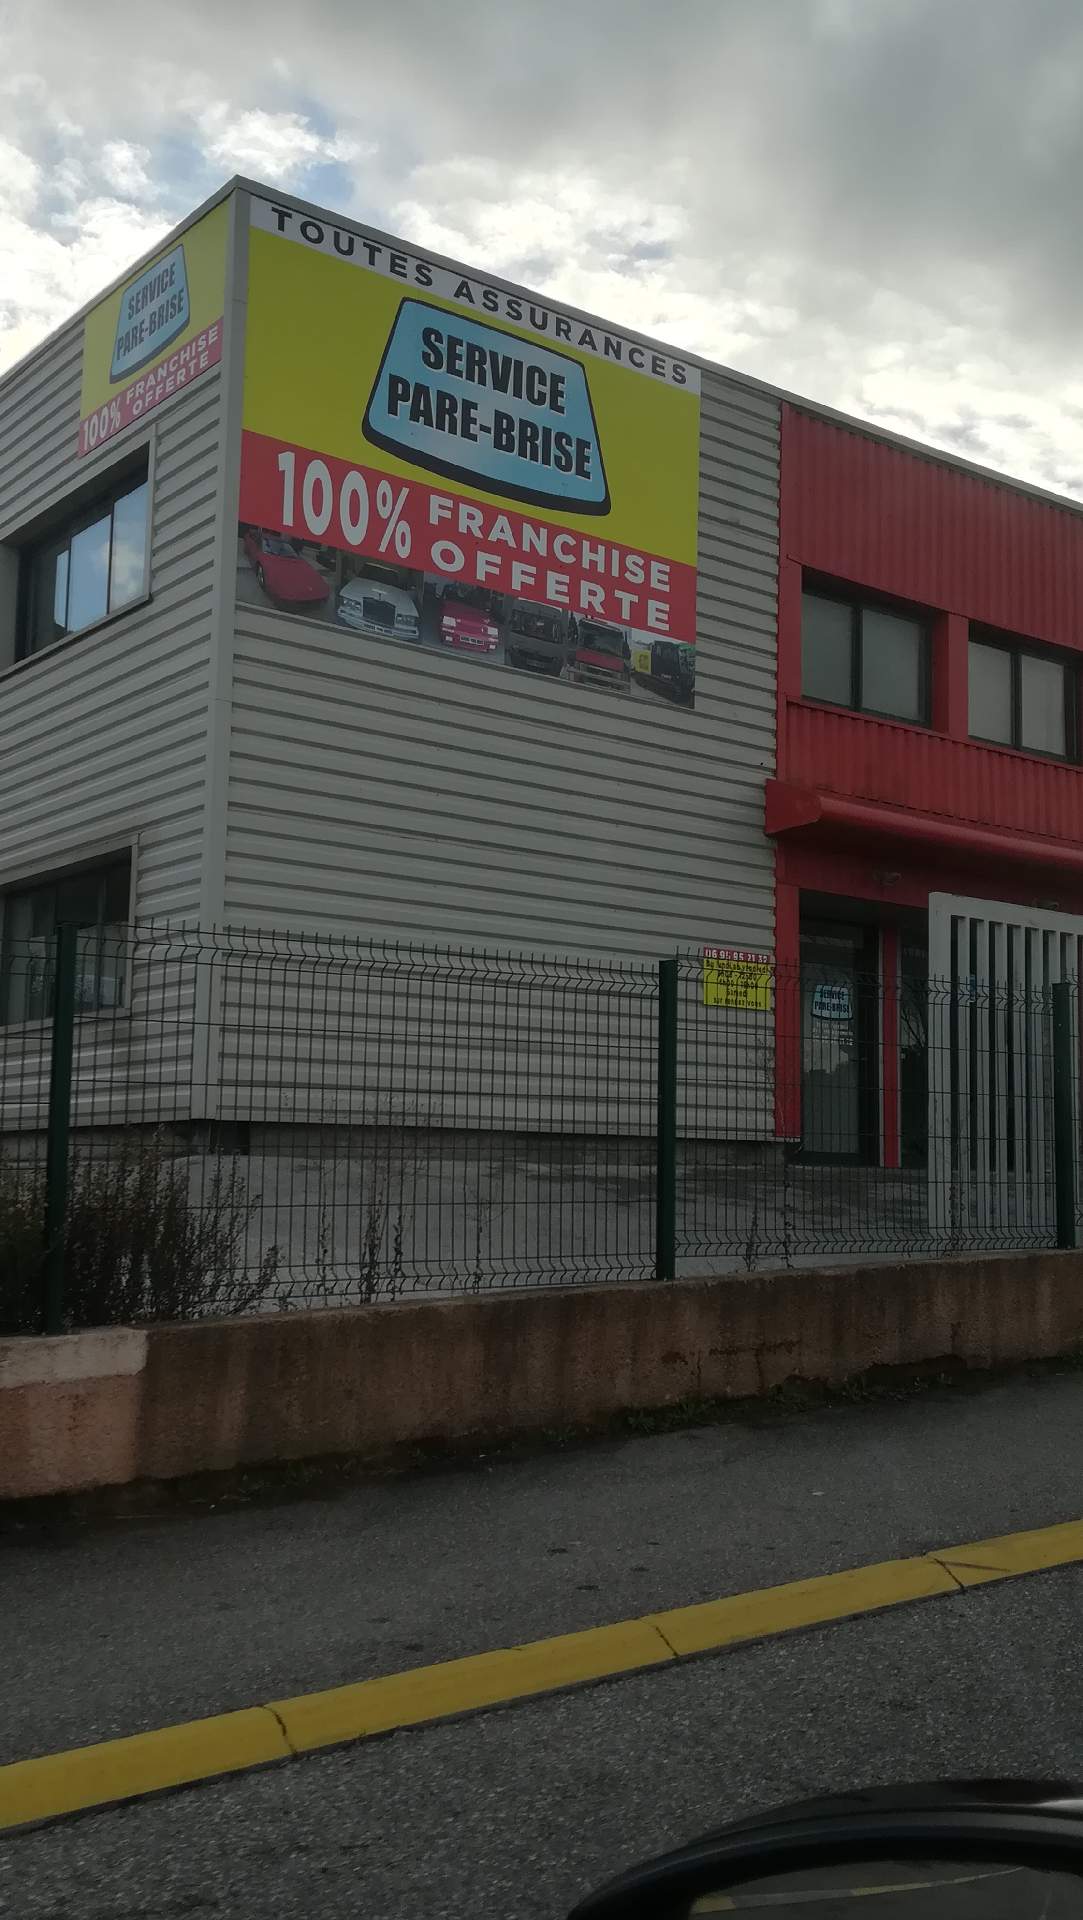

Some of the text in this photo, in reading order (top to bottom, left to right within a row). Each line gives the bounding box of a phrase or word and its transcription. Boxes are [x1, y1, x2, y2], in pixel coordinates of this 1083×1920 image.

[116, 287, 185, 361] PARE-BRISE
[127, 261, 176, 321] SERVICE
[272, 206, 687, 386] TOUTES ASSURANCES
[126, 326, 219, 405] FRANCHISE
[132, 350, 210, 416] OFFERTE
[421, 326, 567, 415] SERVICE
[83, 395, 122, 451] 100%
[387, 374, 592, 480] PARE-BRISE
[277, 450, 412, 560] 100%
[429, 494, 672, 593] FRANCHISE
[430, 540, 672, 632] OFFERTE
